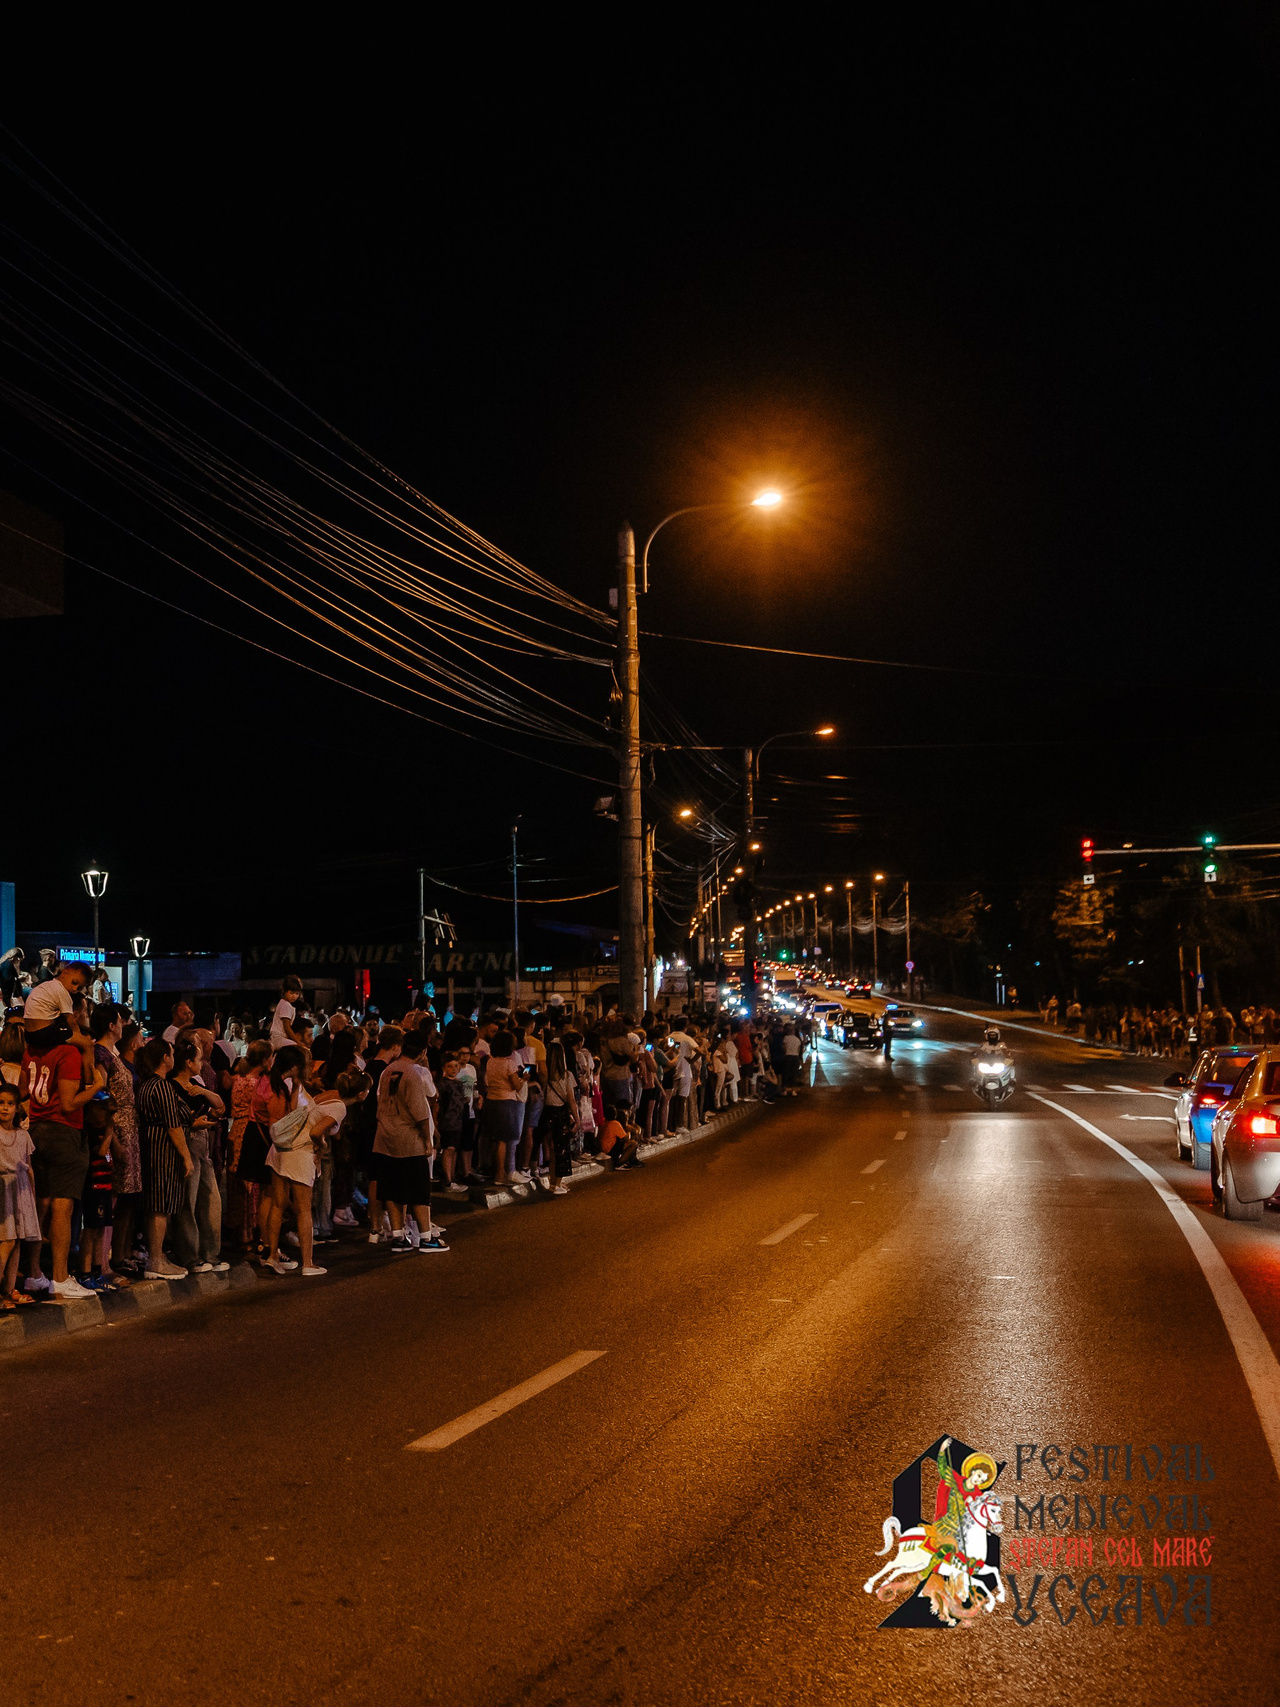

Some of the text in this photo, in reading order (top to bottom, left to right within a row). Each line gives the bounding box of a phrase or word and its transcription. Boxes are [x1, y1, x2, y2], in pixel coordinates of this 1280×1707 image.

[247, 943, 514, 973] STADIONUL ARENI
[28, 1061, 51, 1105] 10
